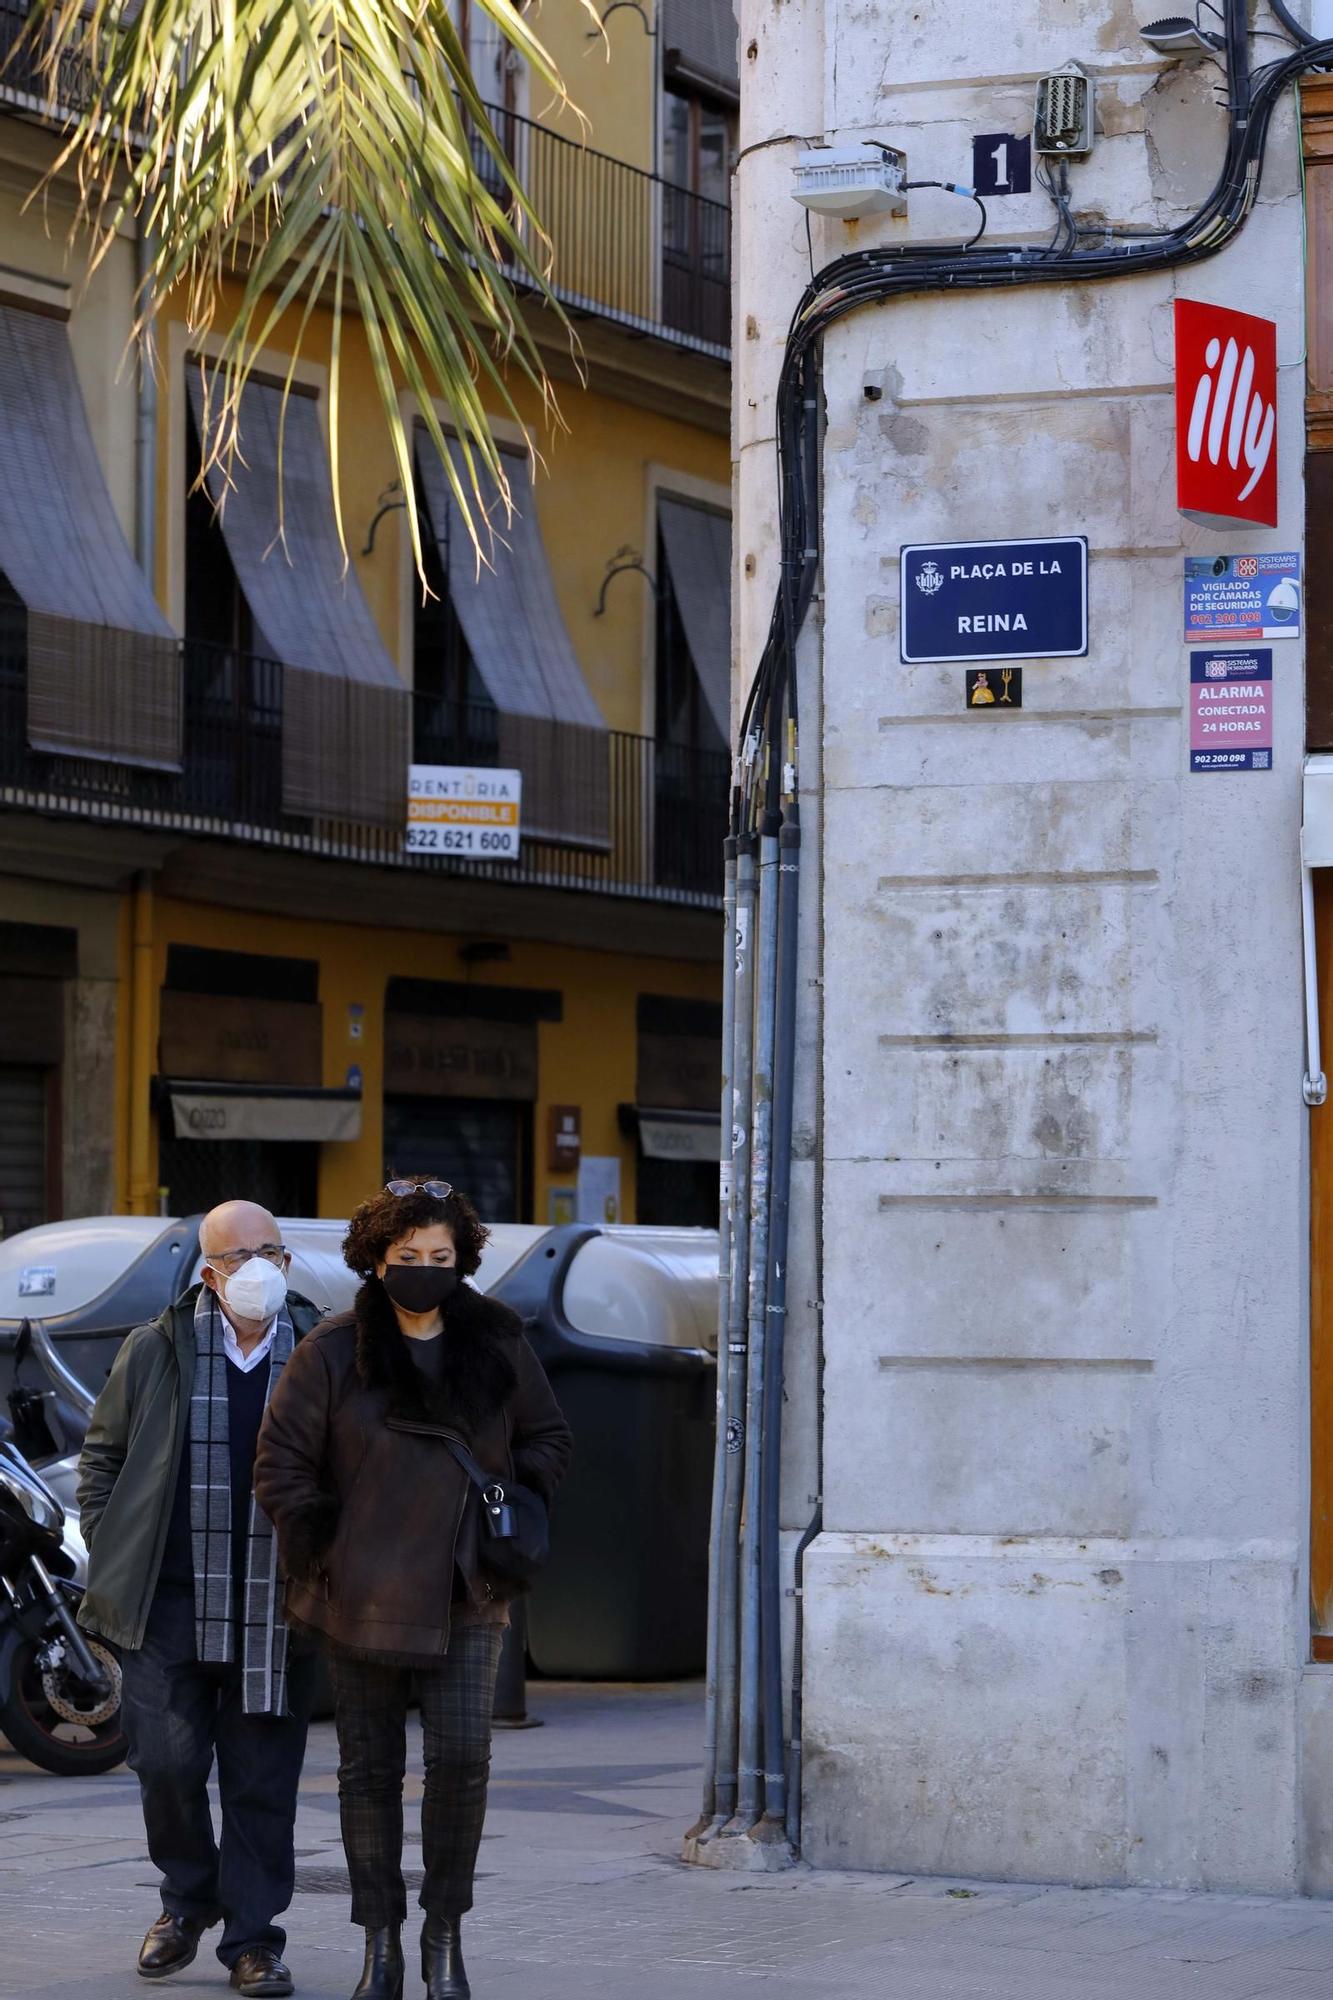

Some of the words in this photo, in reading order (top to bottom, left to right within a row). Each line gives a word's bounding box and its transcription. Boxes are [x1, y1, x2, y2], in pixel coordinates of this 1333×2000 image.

[990, 143, 1009, 186] 1
[1187, 336, 1275, 502] illy
[950, 563, 1007, 579] PLAÇA
[1012, 562, 1034, 576] DE
[1039, 561, 1062, 575] LA
[1202, 581, 1250, 591] VIGILADO
[1190, 593, 1212, 602] POR
[1213, 590, 1262, 601] CÁMARAS
[1190, 602, 1204, 611] DE
[1205, 600, 1262, 611] SEGURIDAD
[957, 613, 1028, 634] REINA
[1190, 614, 1213, 624] 902
[1216, 613, 1237, 624] 200
[1199, 686, 1264, 699] ALARMA
[1197, 705, 1266, 716] CONECTADA
[1202, 723, 1217, 733] 24
[1219, 721, 1261, 732] HORAS
[1194, 755, 1211, 764] 902
[1211, 754, 1228, 763] 200
[1229, 754, 1246, 762] 098
[408, 802, 513, 822] DISPONIBLE
[407, 829, 438, 848] 622
[443, 830, 474, 849] 621
[480, 832, 512, 851] 600
